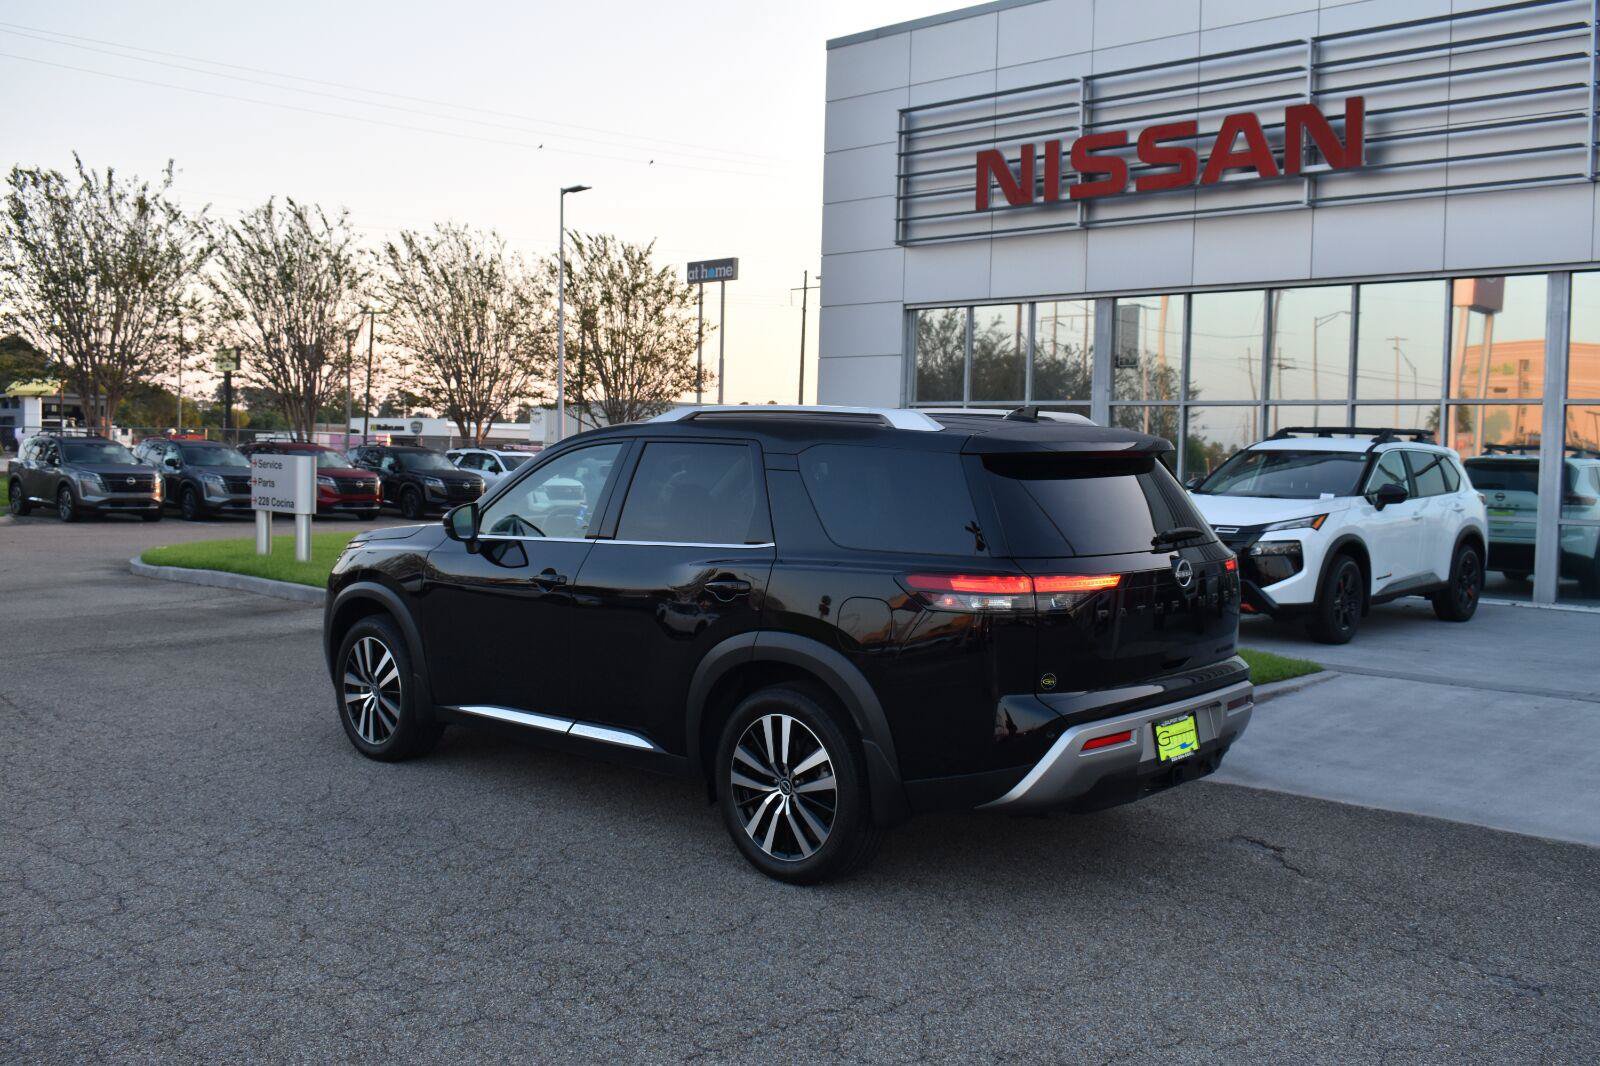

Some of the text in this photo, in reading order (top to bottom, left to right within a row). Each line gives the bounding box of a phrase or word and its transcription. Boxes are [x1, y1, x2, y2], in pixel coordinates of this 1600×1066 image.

[976, 96, 1364, 211] NISSAN
[688, 264, 733, 280] at home
[258, 460, 283, 469] Service
[258, 478, 275, 487] Parts
[271, 497, 295, 509] Cocina
